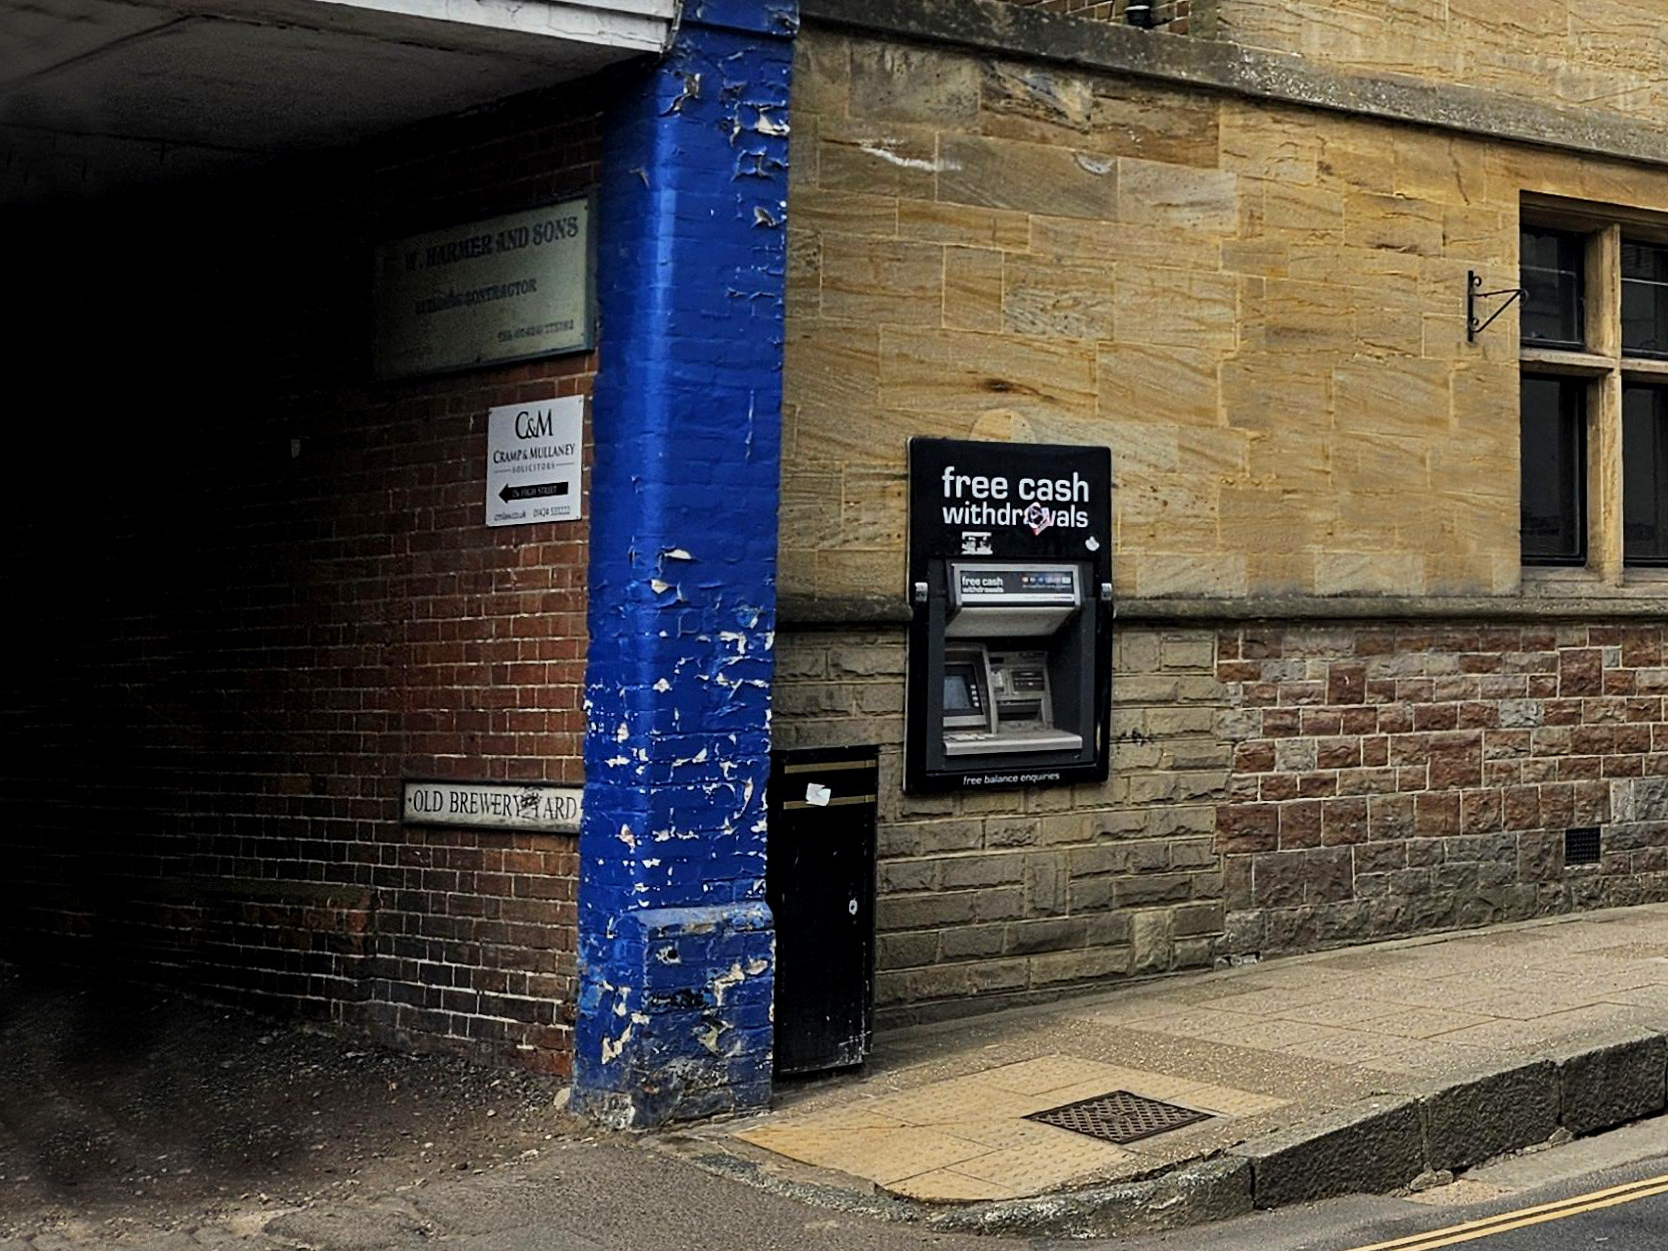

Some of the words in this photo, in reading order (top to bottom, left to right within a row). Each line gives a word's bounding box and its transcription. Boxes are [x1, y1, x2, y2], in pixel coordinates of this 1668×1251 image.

[496, 226, 528, 251] AND
[533, 216, 578, 246] SONS
[515, 409, 553, 440] C&M
[530, 443, 576, 459] MULLANEY
[942, 466, 1008, 499] free
[1019, 472, 1089, 503] cash
[961, 576, 981, 586] free
[982, 576, 1004, 587] cash
[963, 775, 982, 785] free
[984, 774, 1018, 784] balance
[1020, 772, 1060, 783] enquiries
[413, 789, 443, 813] OLD
[449, 791, 523, 818] BREWERY
